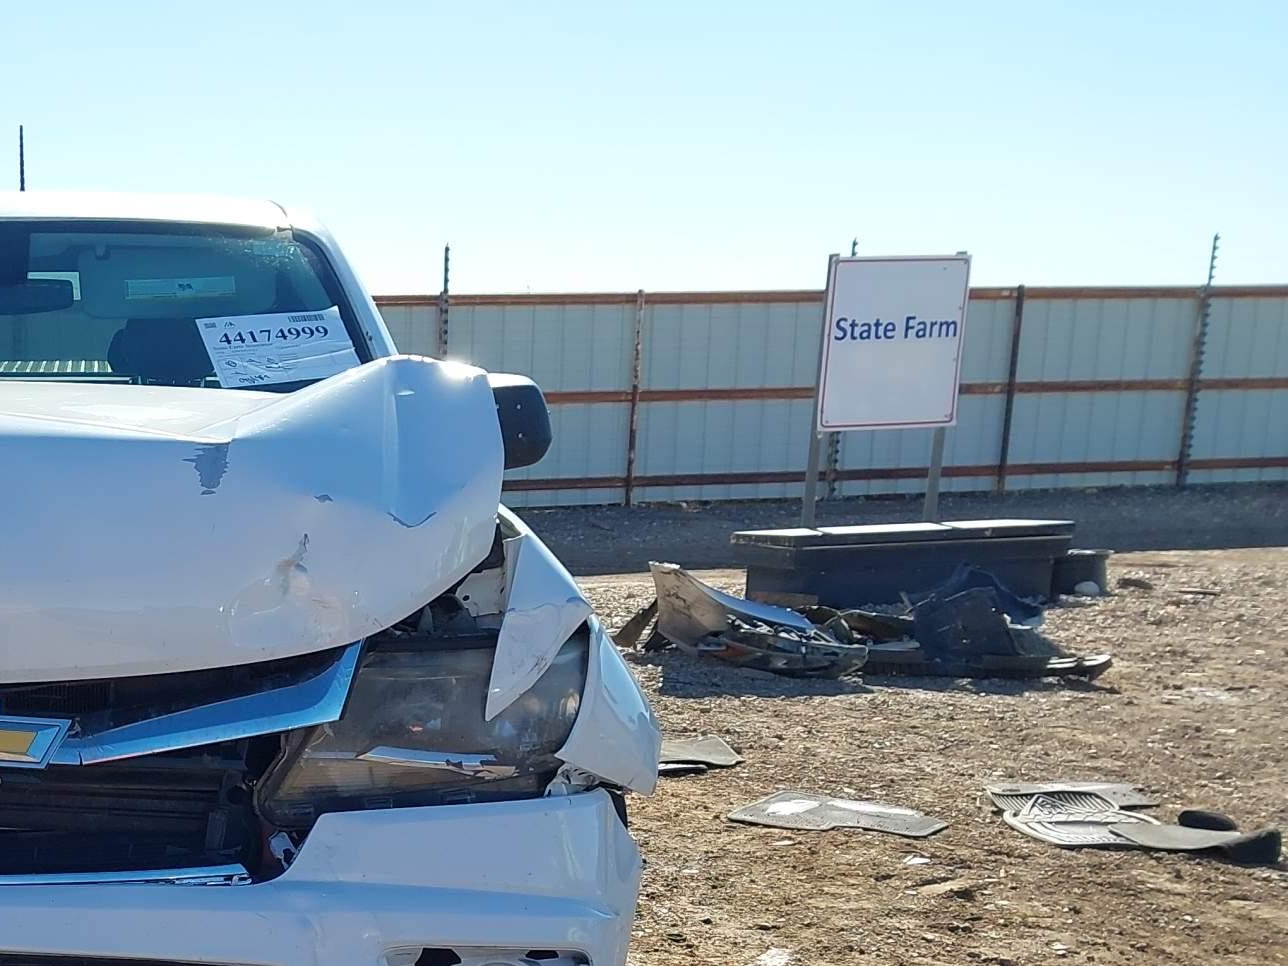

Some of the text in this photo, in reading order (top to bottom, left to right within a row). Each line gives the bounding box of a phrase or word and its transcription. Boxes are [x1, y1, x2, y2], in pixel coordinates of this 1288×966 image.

[218, 325, 329, 346] 44174999
[834, 315, 958, 341] State Farm
